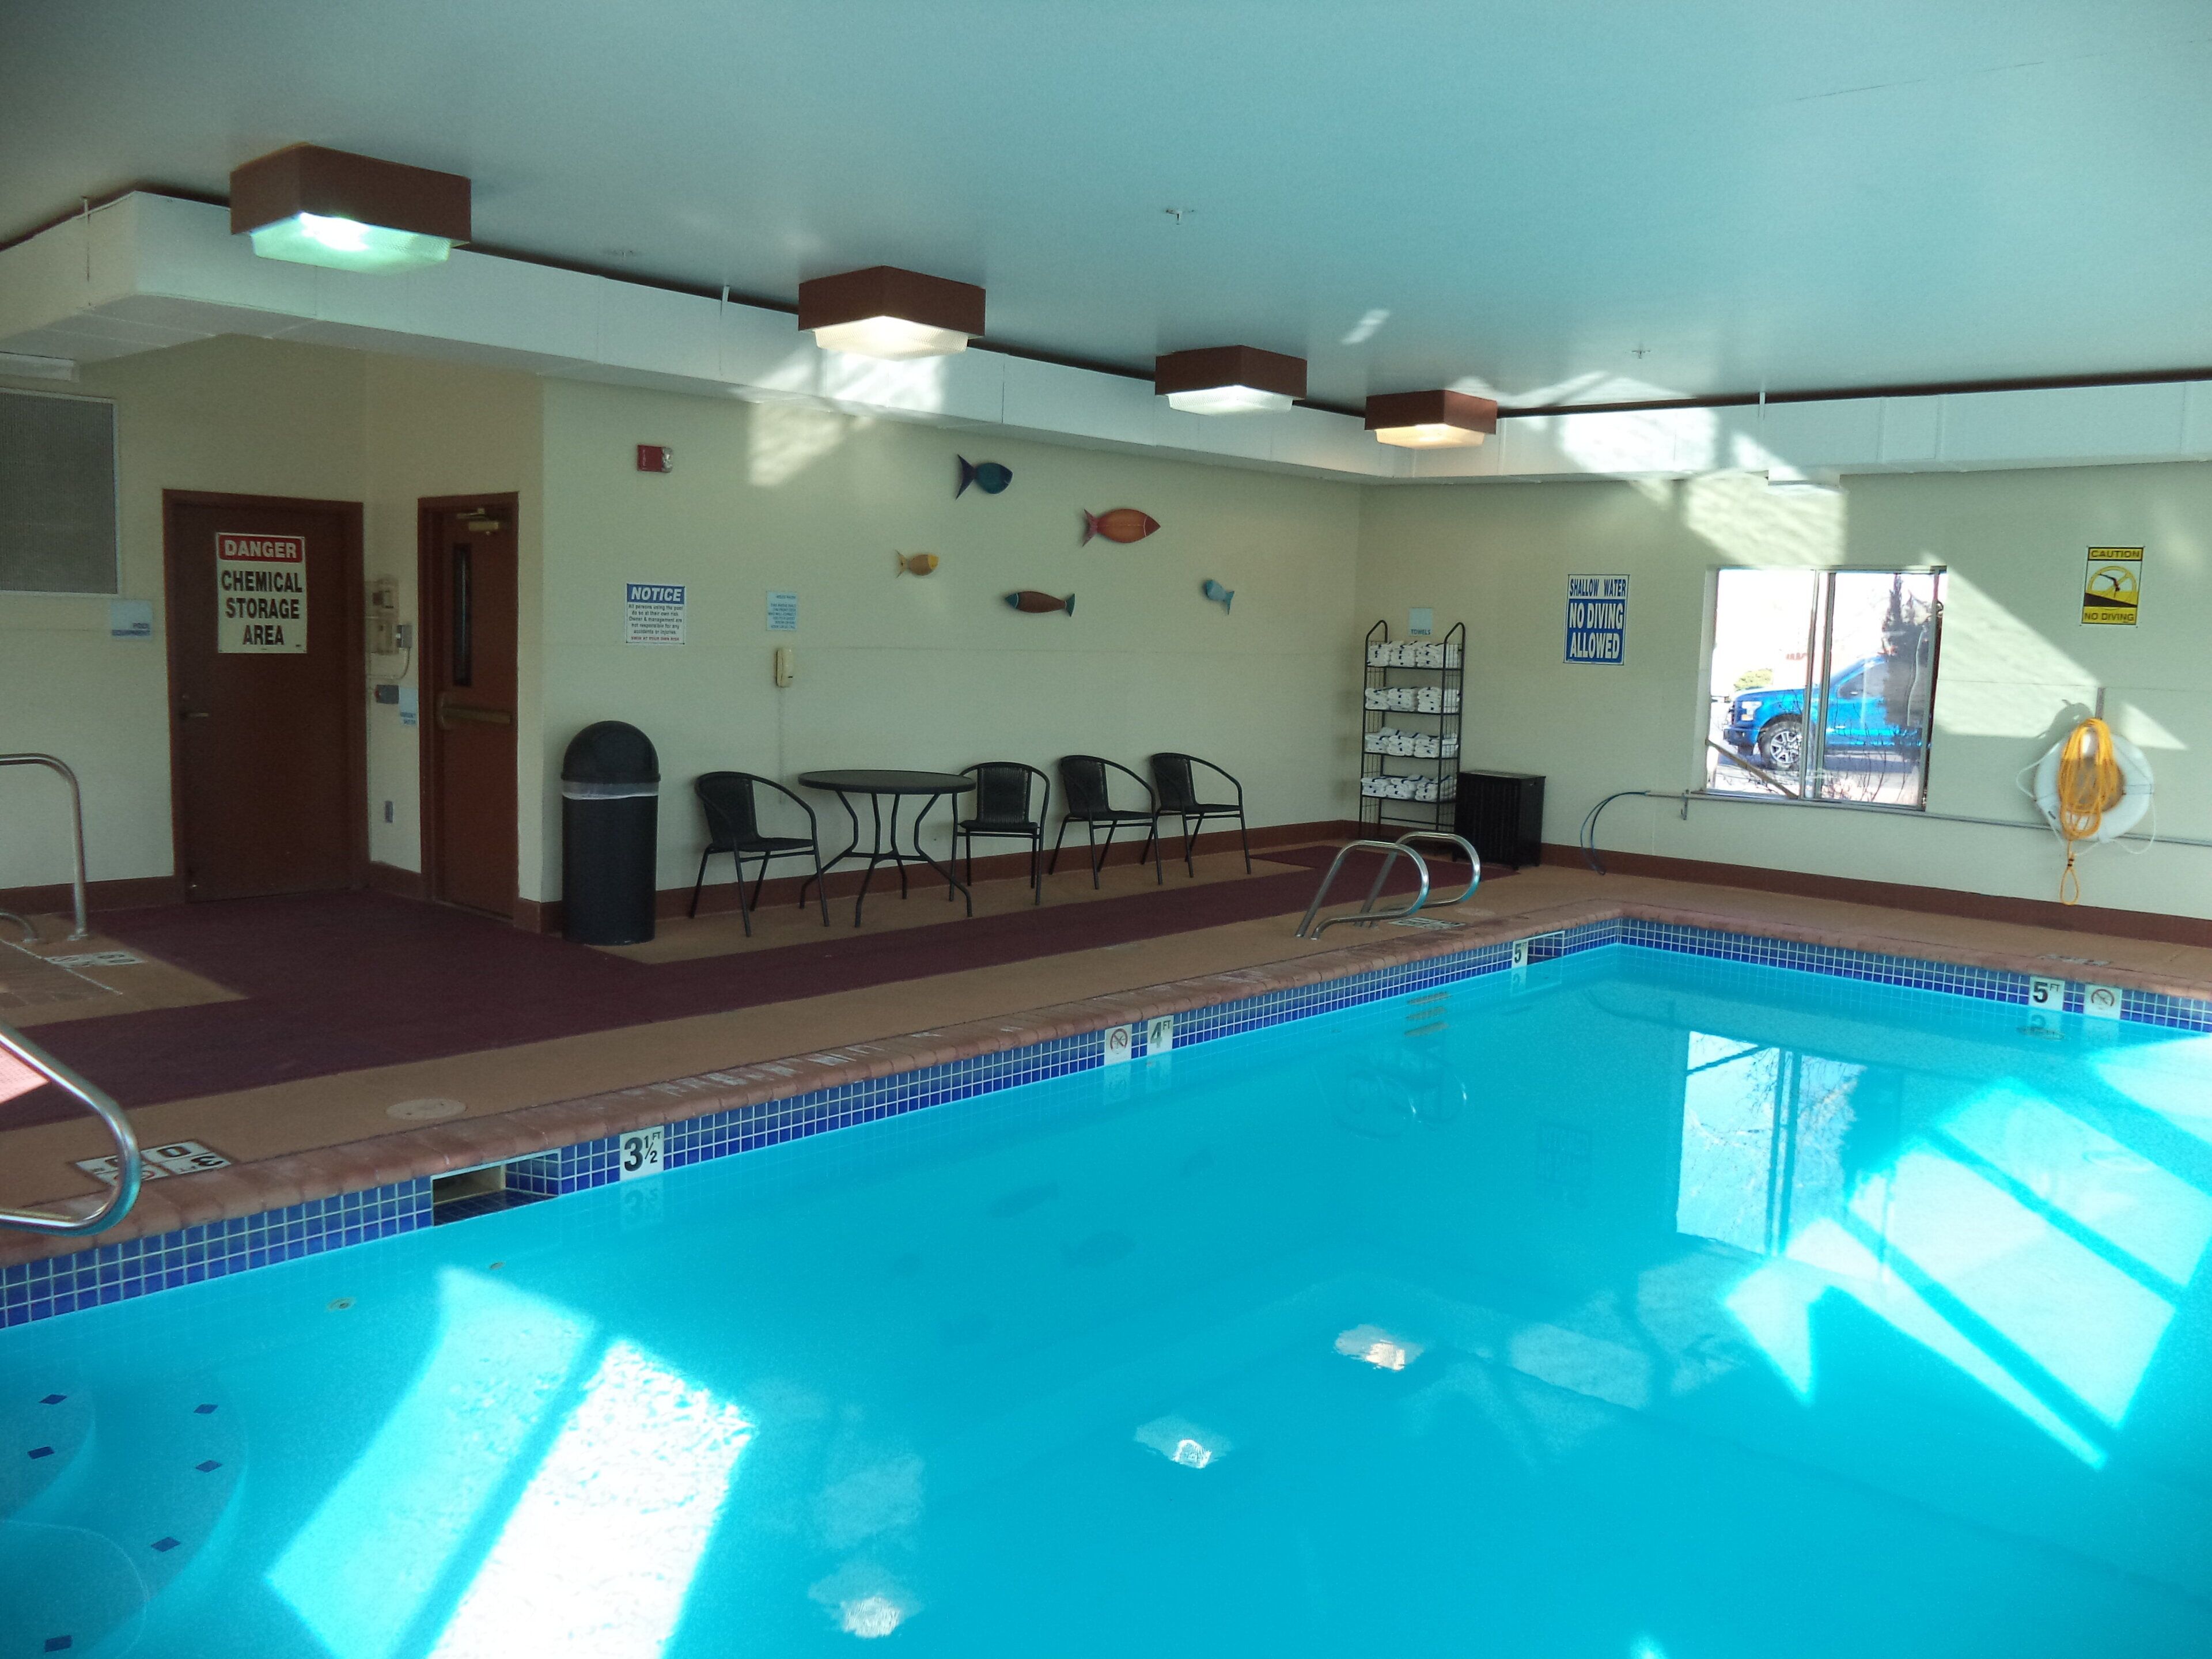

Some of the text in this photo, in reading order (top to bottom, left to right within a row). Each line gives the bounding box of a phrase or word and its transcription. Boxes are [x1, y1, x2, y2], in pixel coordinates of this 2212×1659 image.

[224, 540, 297, 559] DANGER
[221, 570, 303, 593] CHEMICAL
[1570, 578, 1626, 597] SHALLOW WATER
[631, 587, 682, 602] NOTICE
[225, 597, 300, 619] STORAGE
[1569, 603, 1623, 630] NO DIVING
[2101, 613, 2134, 621] DIVING
[242, 624, 285, 645] AREA
[1570, 632, 1620, 659] ALLOWED
[1514, 942, 1521, 963] 5
[2033, 982, 2061, 1003] 5 FT
[1150, 1020, 1171, 1048] 4 FT
[624, 1137, 643, 1172] 3
[652, 1131, 661, 1141] FT
